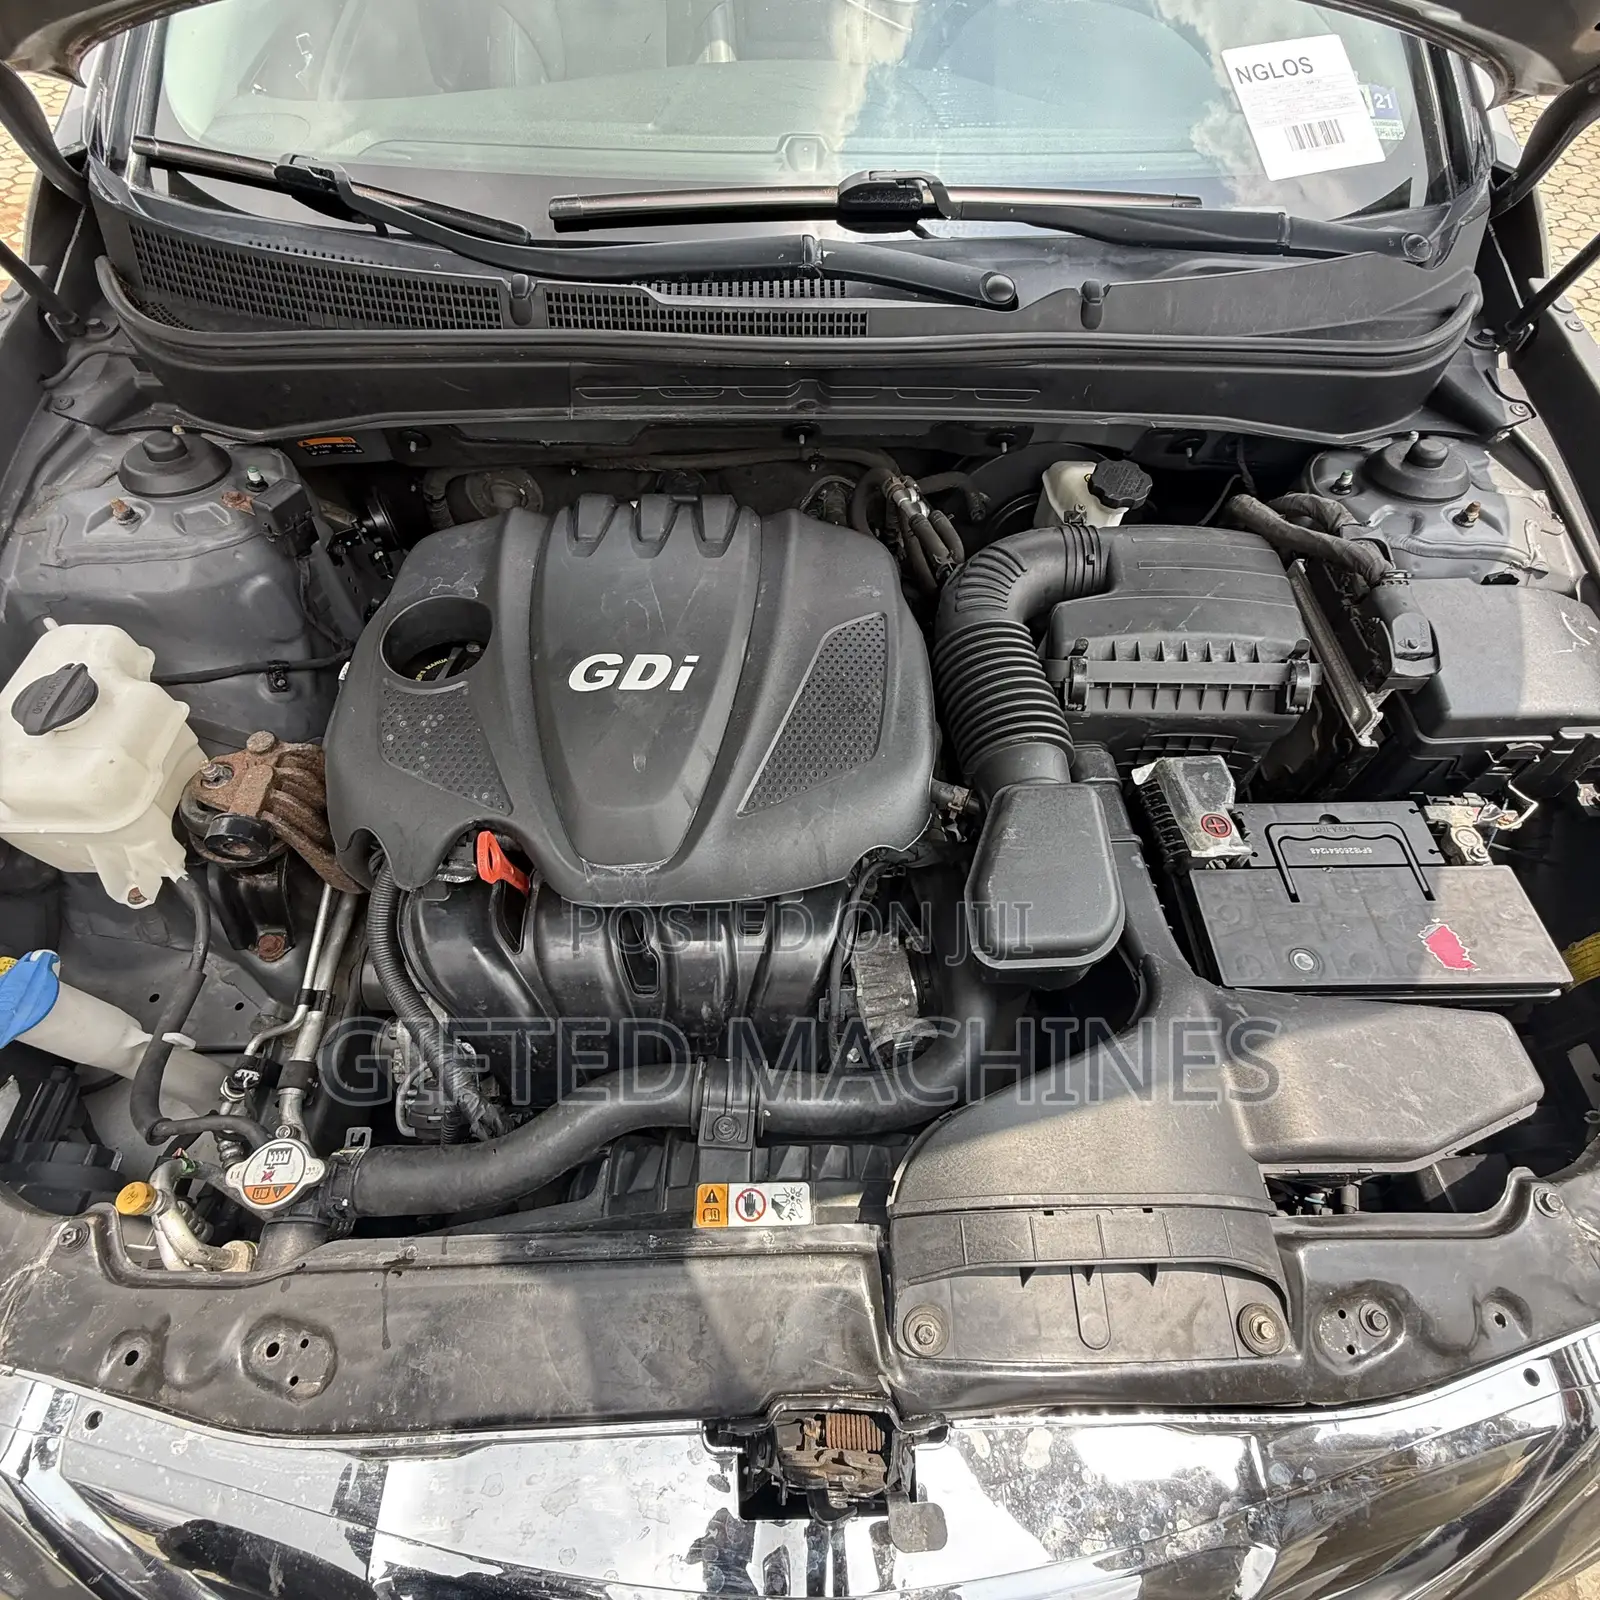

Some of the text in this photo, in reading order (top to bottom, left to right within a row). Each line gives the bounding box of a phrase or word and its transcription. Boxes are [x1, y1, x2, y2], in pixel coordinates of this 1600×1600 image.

[1235, 56, 1314, 85] NGLOS
[1373, 92, 1394, 110] 21
[568, 653, 700, 692] GDi
